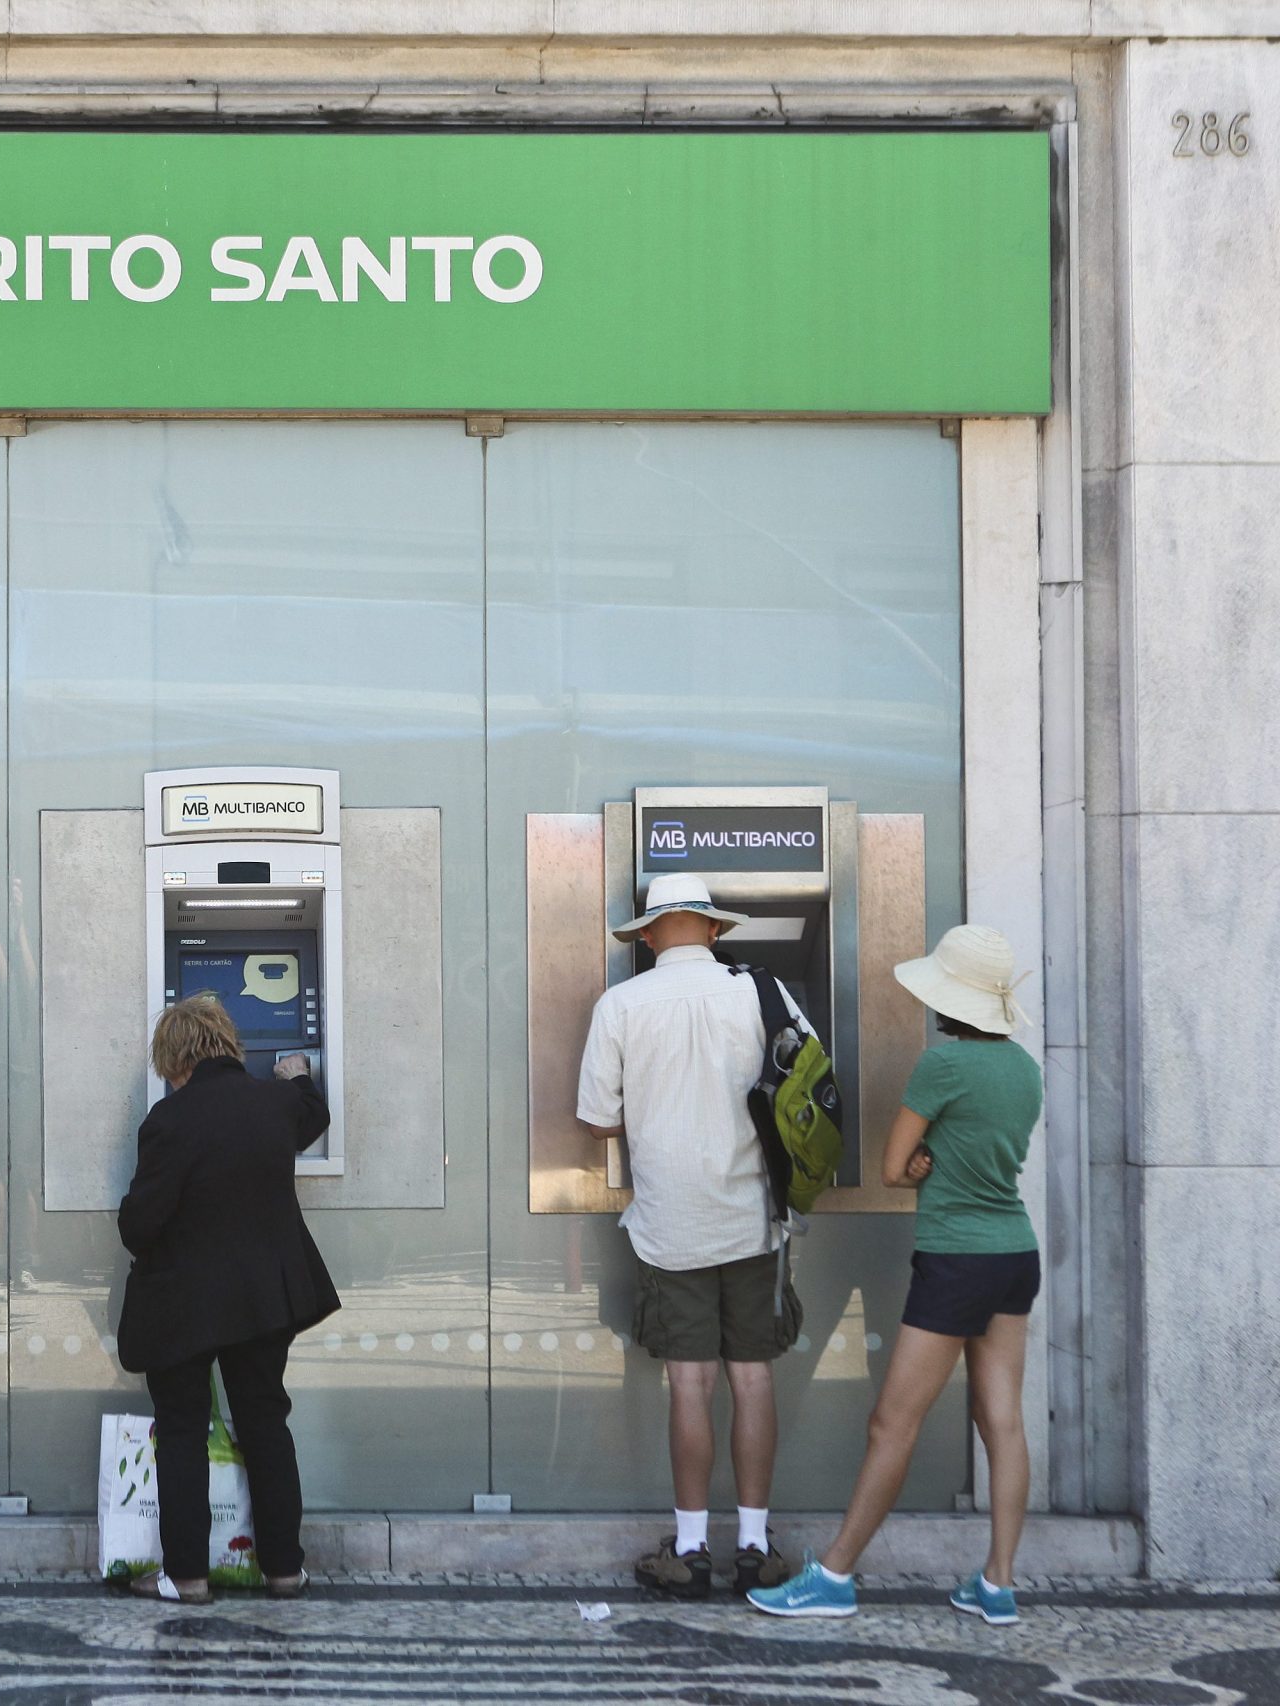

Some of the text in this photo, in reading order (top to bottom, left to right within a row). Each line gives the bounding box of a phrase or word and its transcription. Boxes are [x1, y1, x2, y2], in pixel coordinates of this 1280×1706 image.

[1171, 109, 1251, 158] 286
[210, 234, 544, 304] SANTO
[182, 801, 306, 816] MB MULTIBANCO
[650, 830, 815, 849] MB MULTIBANCO
